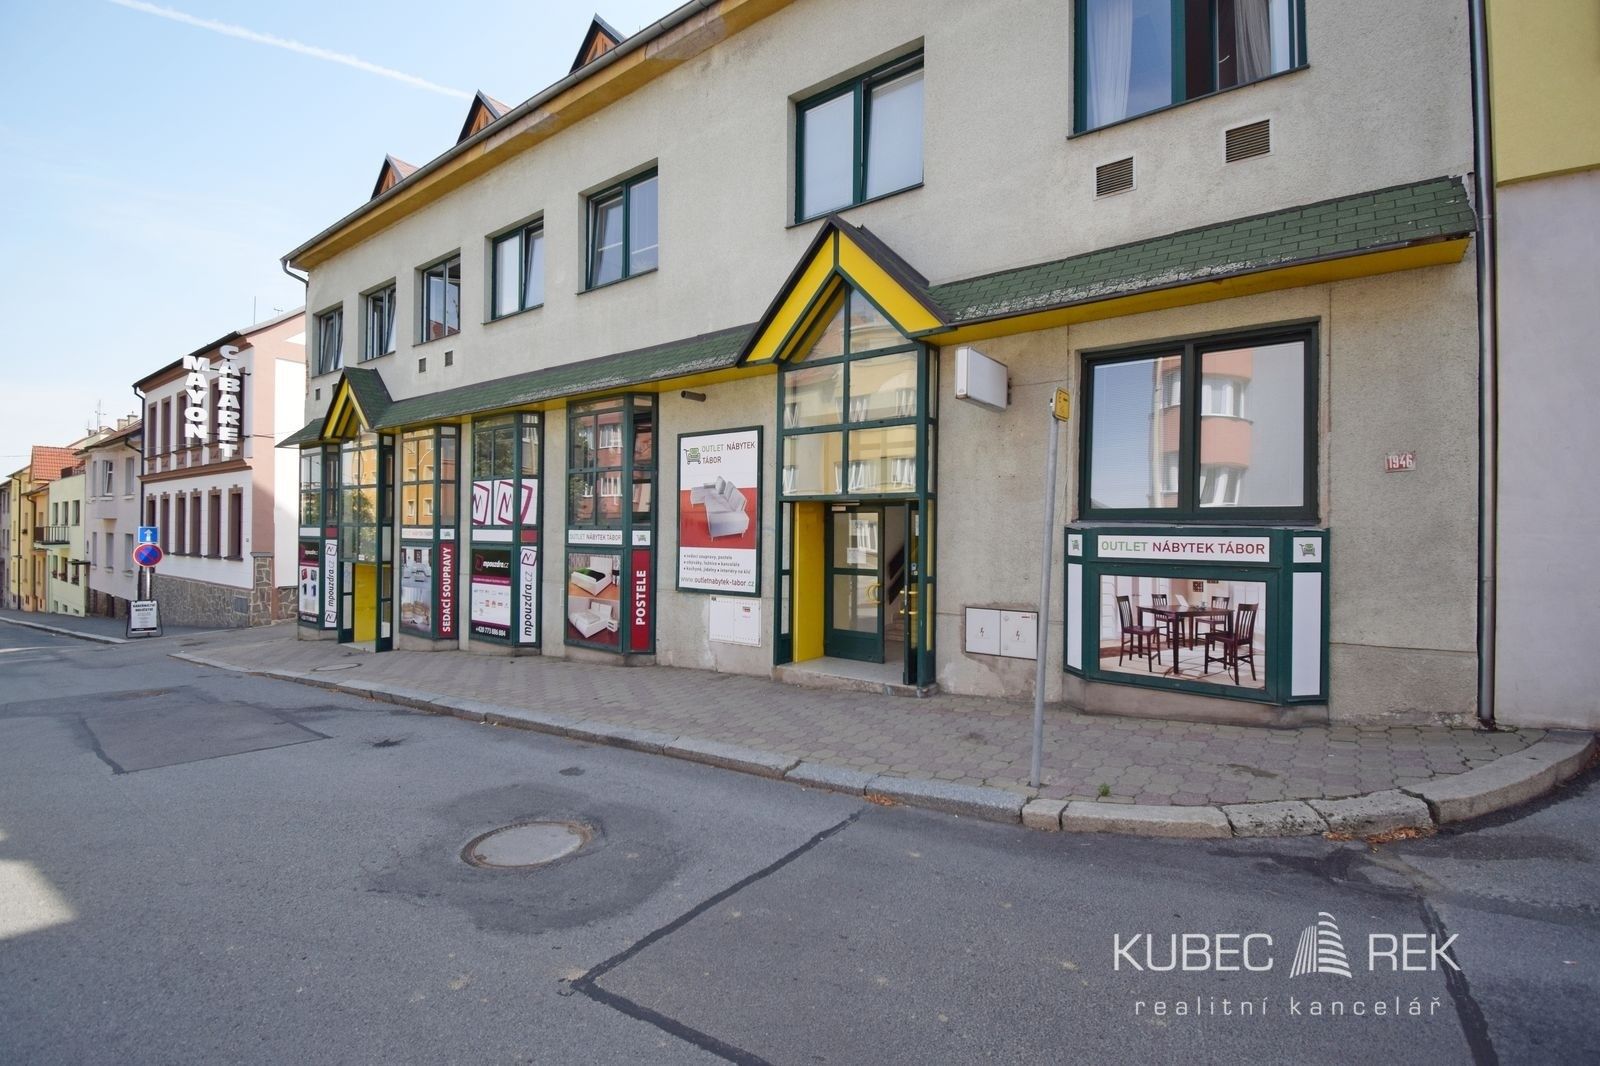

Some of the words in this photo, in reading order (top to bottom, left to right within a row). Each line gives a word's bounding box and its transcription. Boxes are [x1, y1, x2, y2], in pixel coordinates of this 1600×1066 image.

[183, 355, 210, 438] MAYON
[217, 345, 240, 457] CABARET
[702, 444, 724, 453] OUTLET
[727, 441, 755, 451] NÁBYTEK
[702, 456, 722, 464] TÁBOR
[1388, 455, 1412, 468] 1946
[586, 532, 606, 540] NÁBYTEK
[1101, 541, 1148, 552] OUTLET
[1152, 540, 1215, 554] NÁBYTEK
[1217, 540, 1265, 555] TÁBOR
[443, 547, 452, 597] SOUPRAVY
[524, 571, 534, 637] mpouzdra.cz
[635, 570, 646, 625] POSTELE
[441, 599, 451, 632] SEDACÍ
